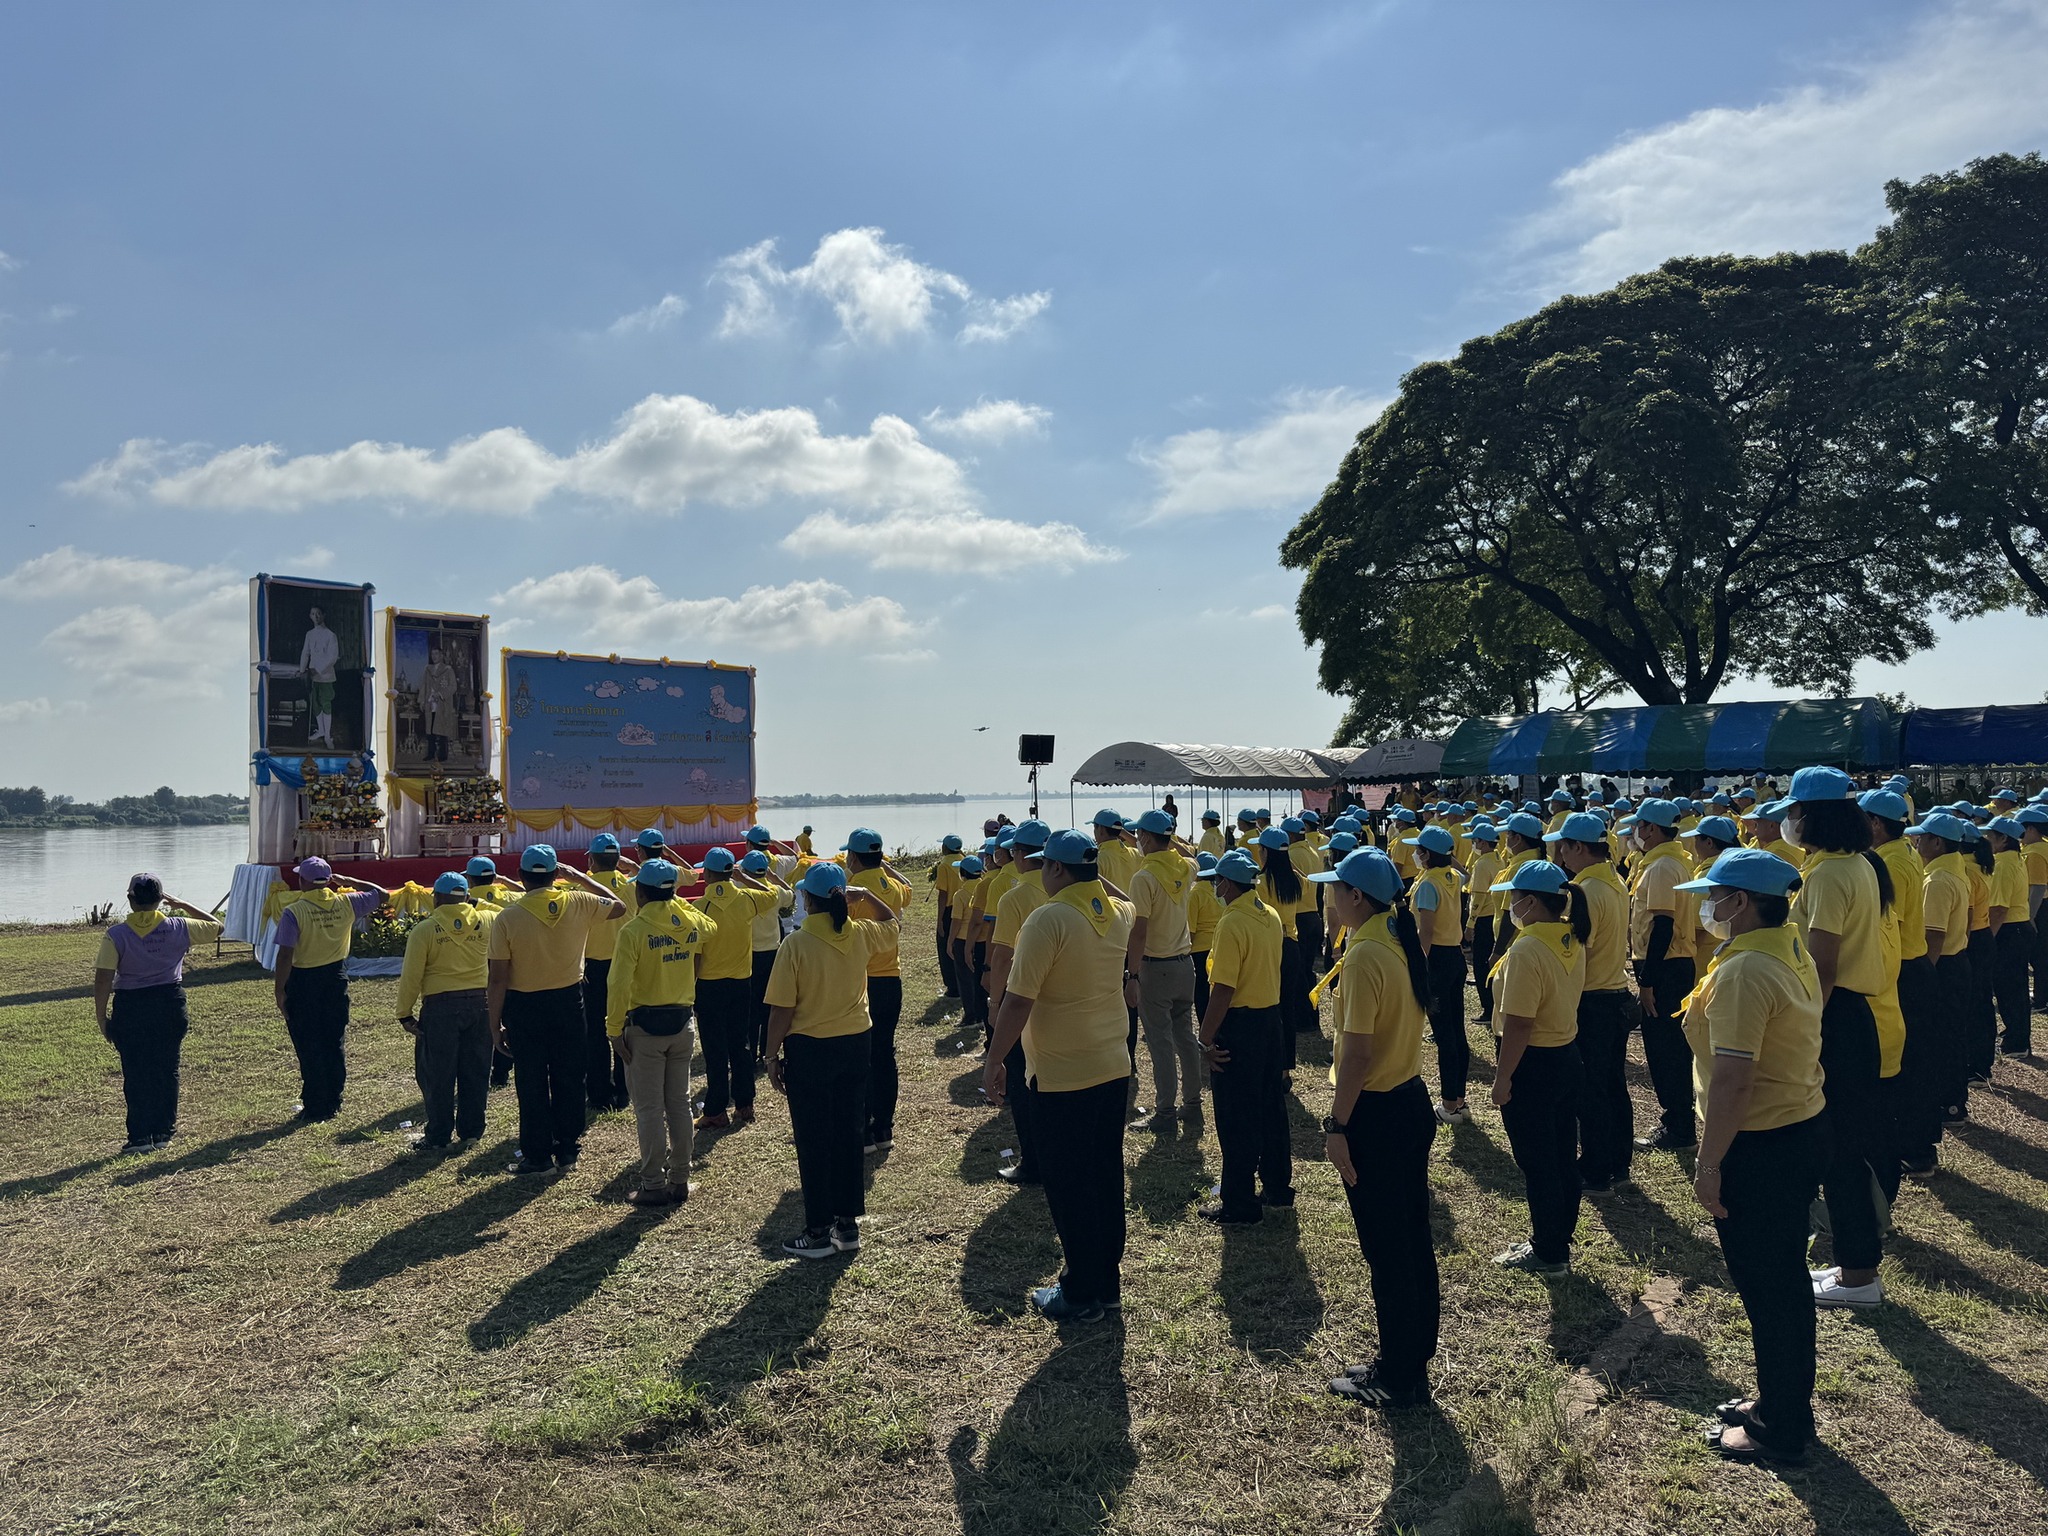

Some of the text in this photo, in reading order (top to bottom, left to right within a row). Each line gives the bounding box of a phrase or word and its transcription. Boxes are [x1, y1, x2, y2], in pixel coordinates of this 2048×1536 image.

[540, 700, 625, 716] โครงการจิตอาสา
